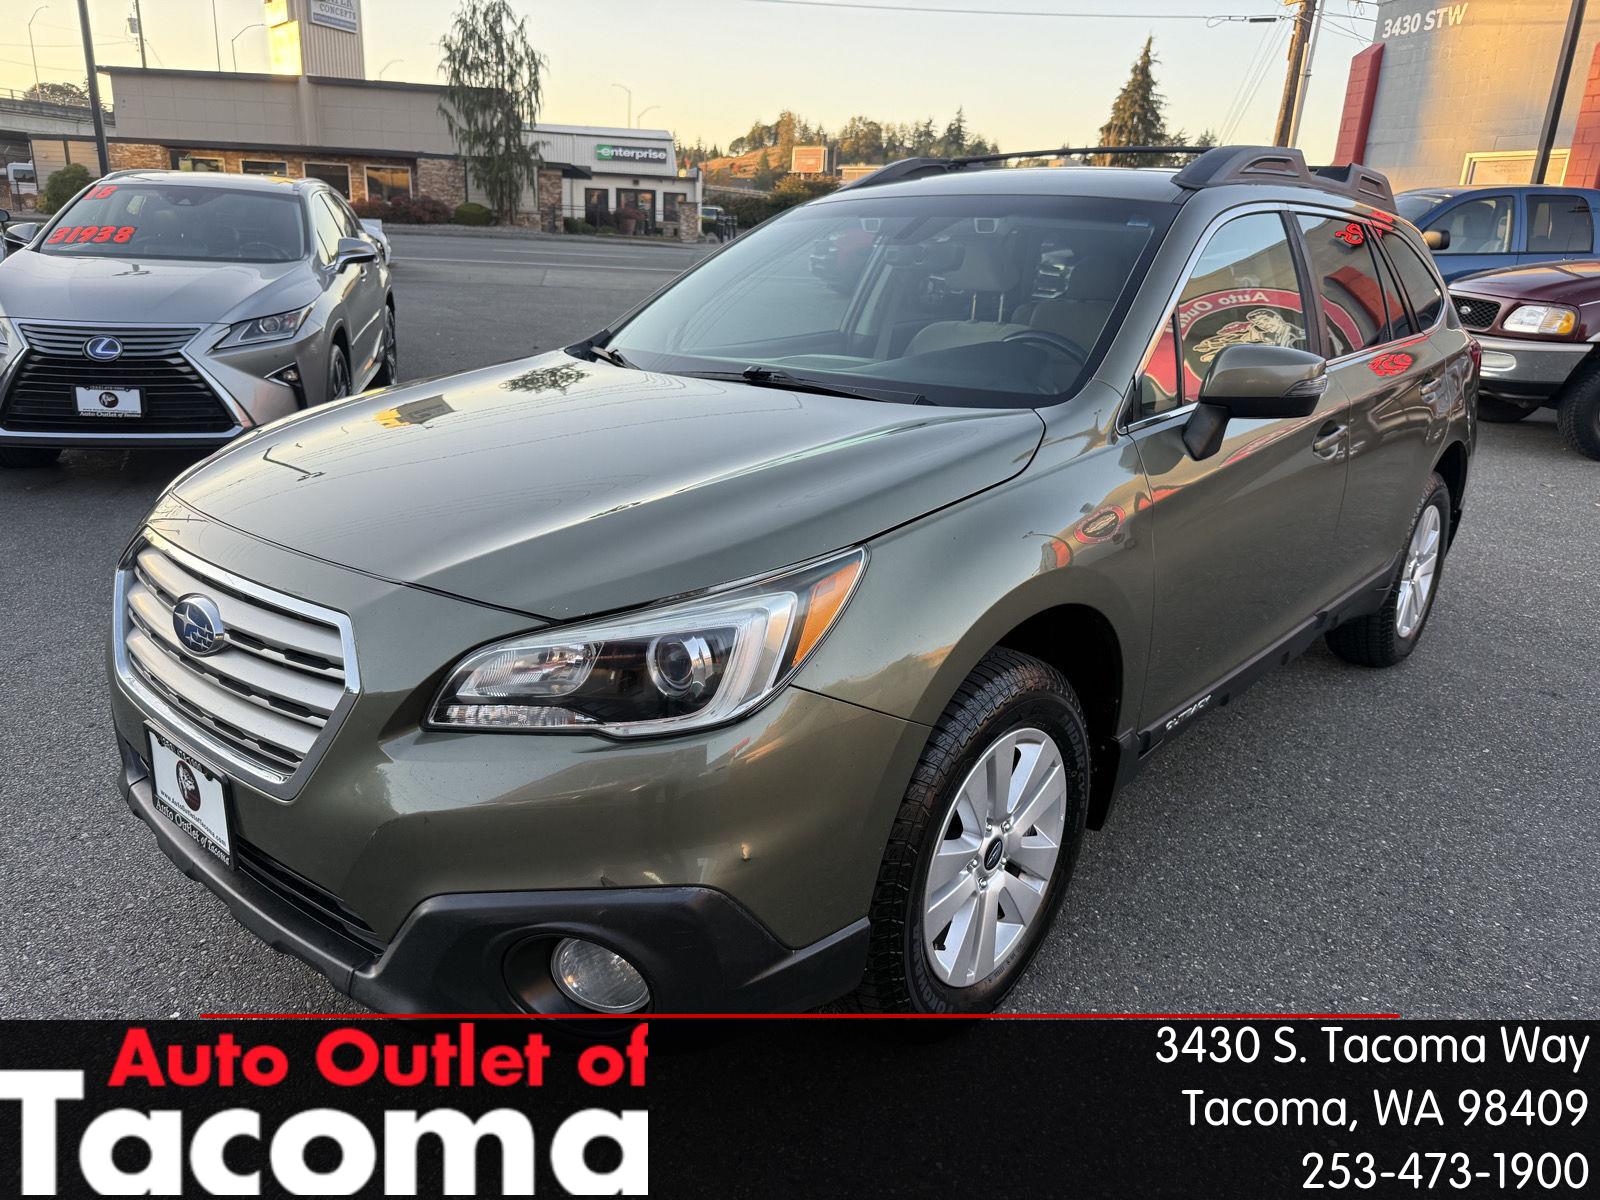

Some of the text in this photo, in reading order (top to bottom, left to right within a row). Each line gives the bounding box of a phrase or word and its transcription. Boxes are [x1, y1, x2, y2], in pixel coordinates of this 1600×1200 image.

[320, 3, 356, 20] CONCEPTS
[1382, 2, 1469, 38] 3430 STW
[598, 148, 666, 160] enterprise
[47, 226, 136, 244] 31938
[156, 798, 174, 821] Auto
[175, 813, 200, 843] Outlet
[200, 837, 208, 849] of
